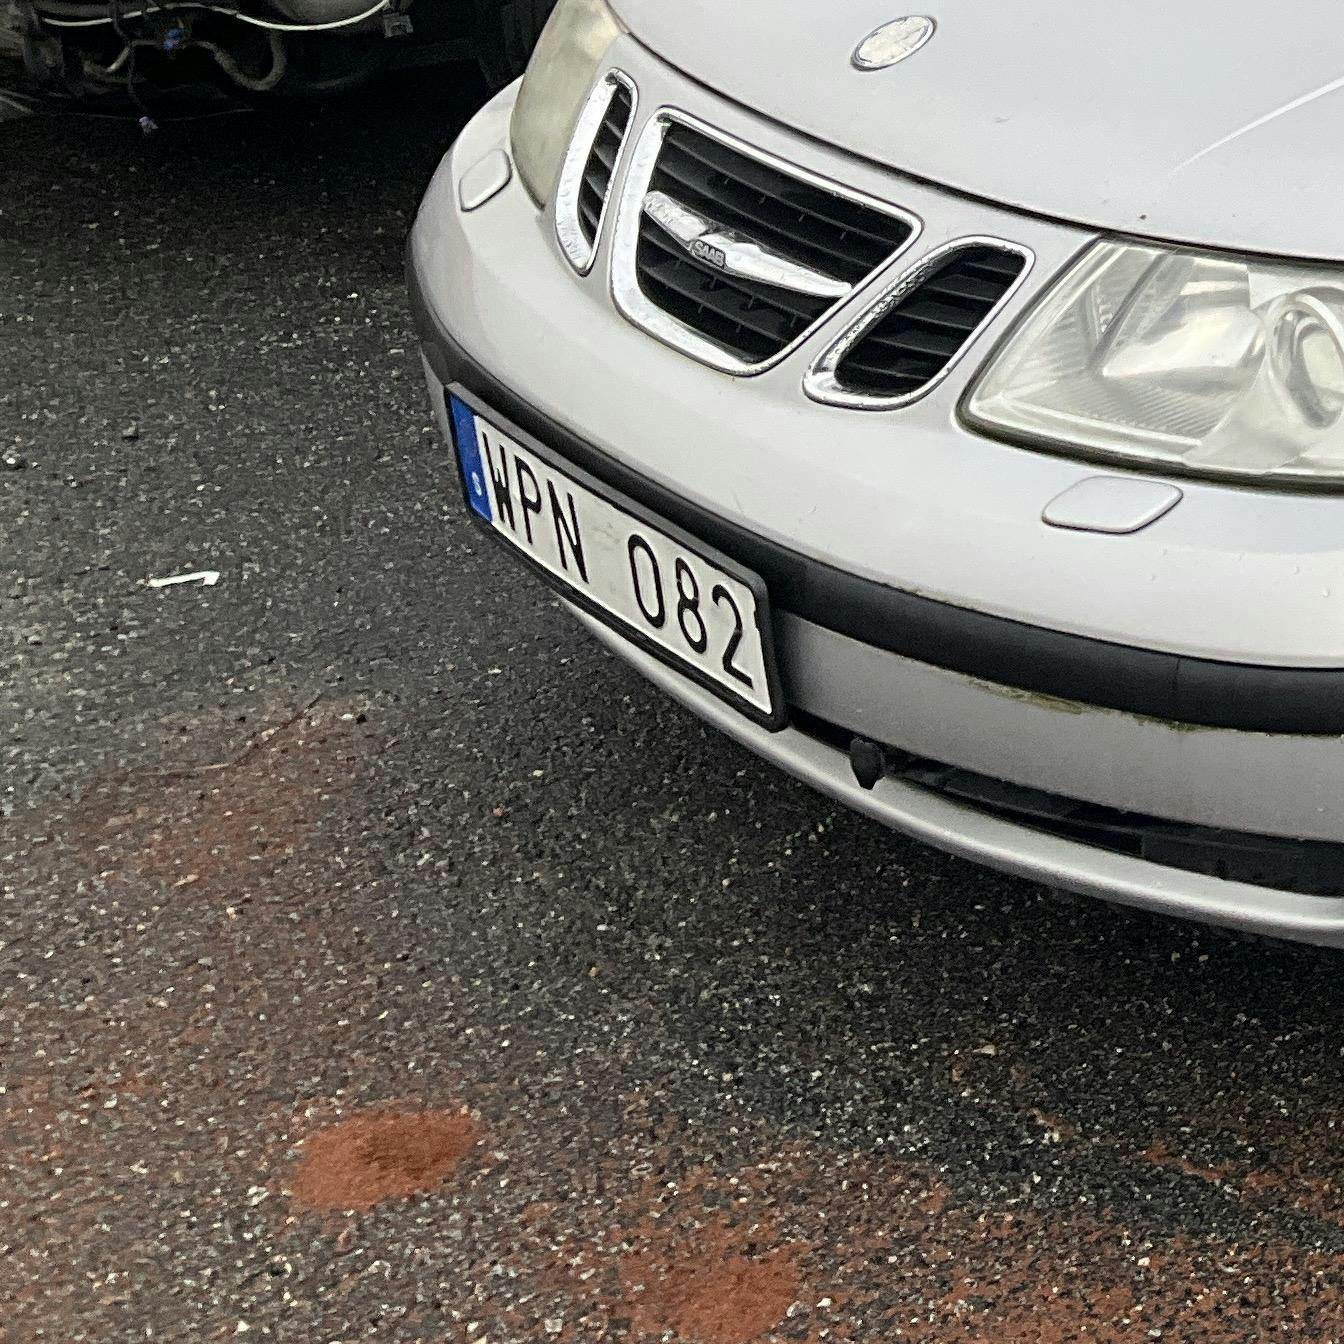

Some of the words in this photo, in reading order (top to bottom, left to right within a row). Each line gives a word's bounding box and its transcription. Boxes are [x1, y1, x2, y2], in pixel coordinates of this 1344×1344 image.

[692, 240, 724, 267] SAAB
[483, 431, 590, 584] WPN
[627, 533, 754, 690] 082
